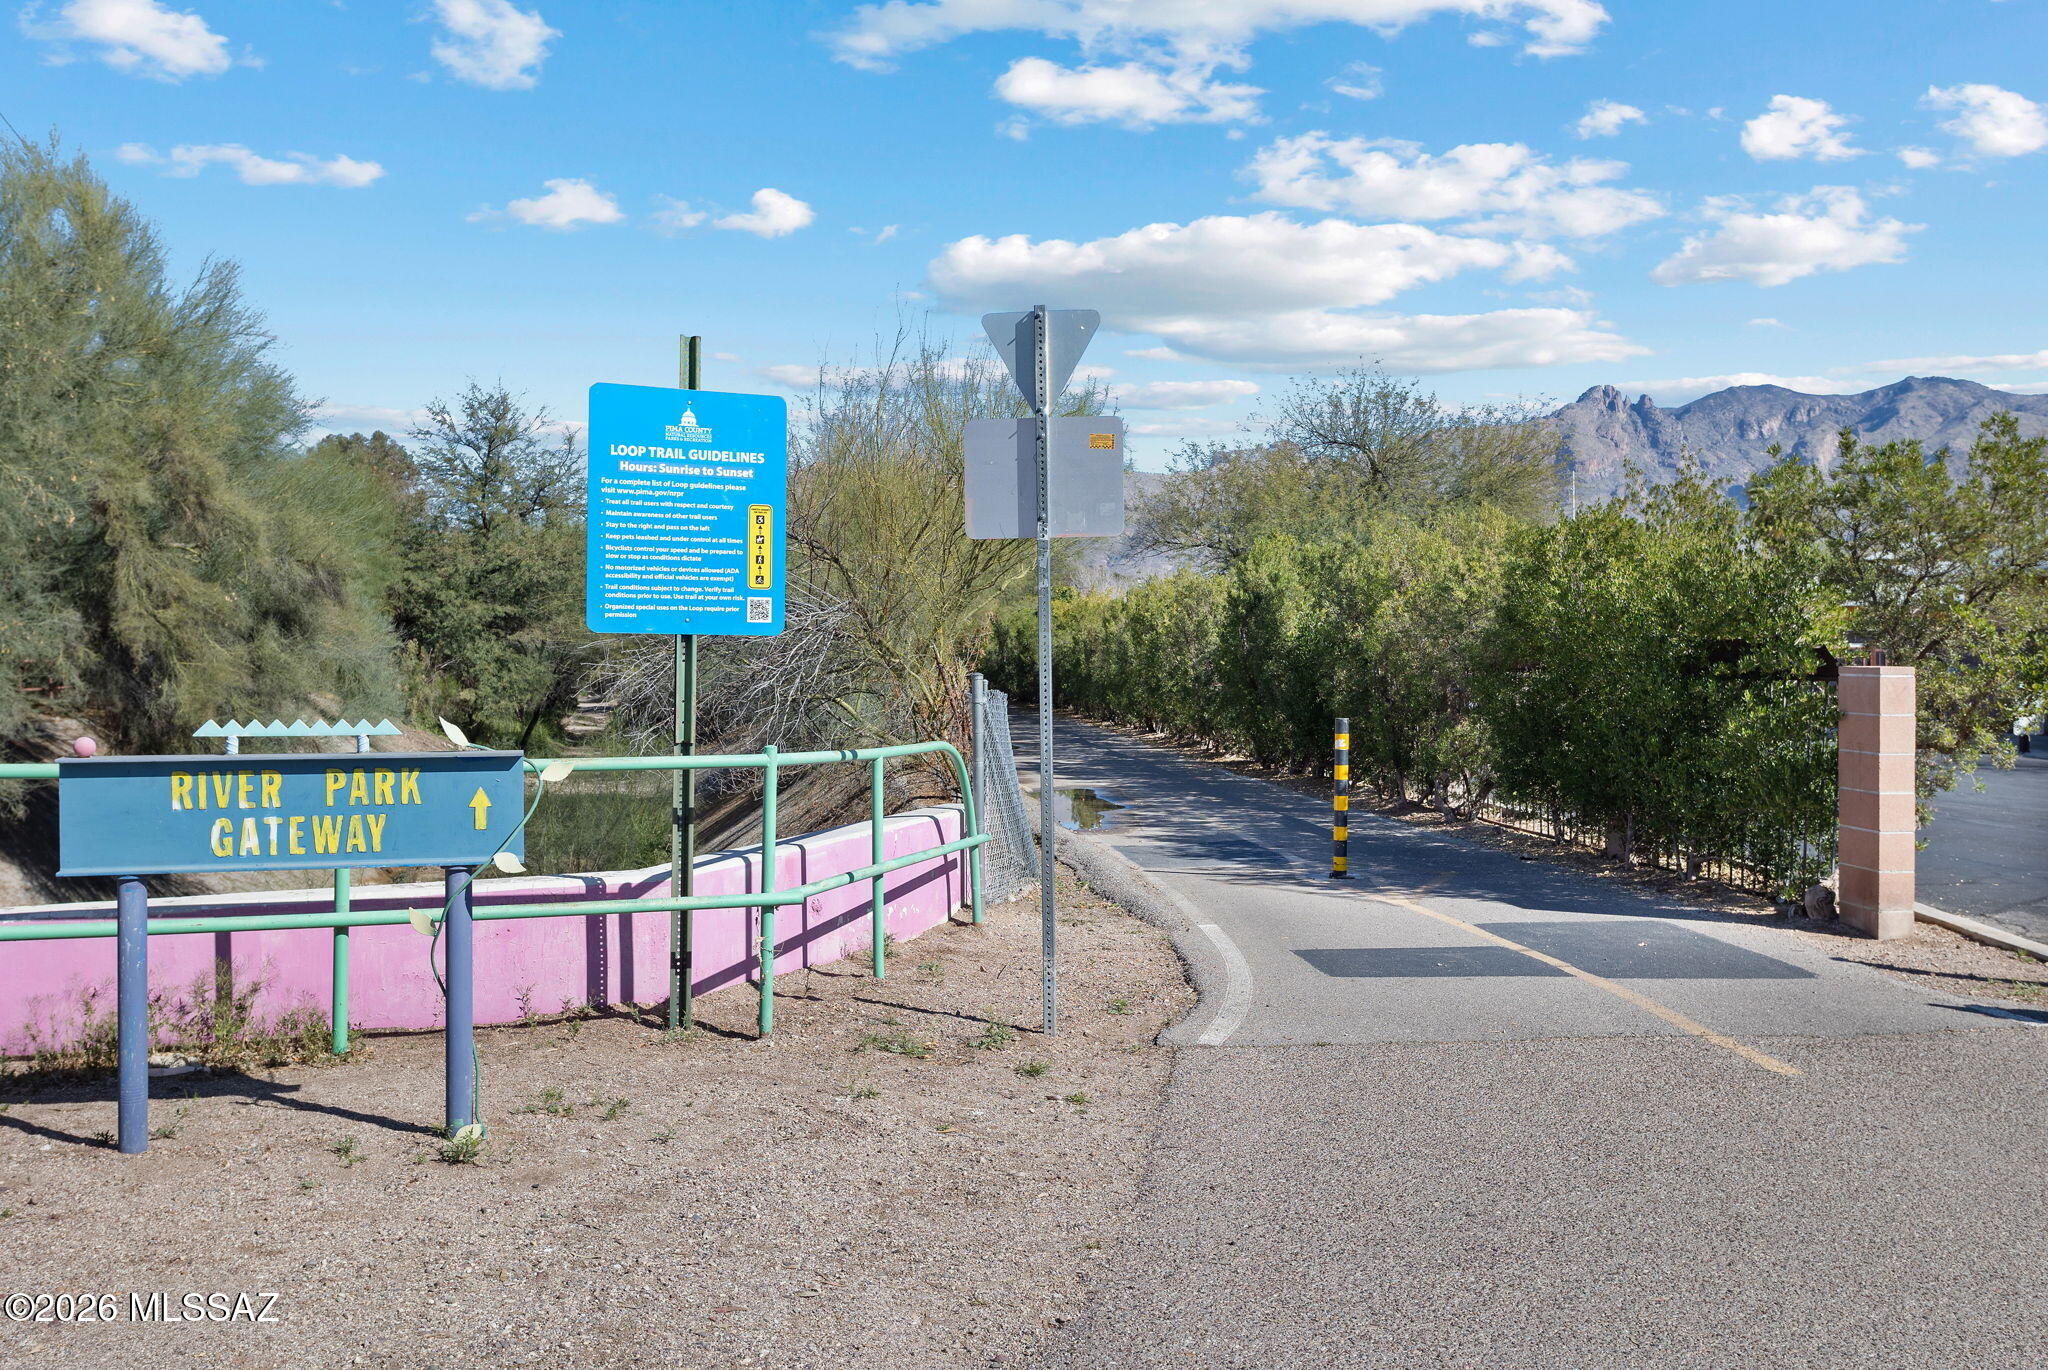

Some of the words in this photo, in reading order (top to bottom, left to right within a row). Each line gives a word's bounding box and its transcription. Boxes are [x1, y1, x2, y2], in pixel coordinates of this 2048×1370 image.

[684, 426, 712, 434] COUNTY
[610, 444, 646, 456] LOOP
[649, 447, 686, 459] TRAIL
[688, 449, 765, 464] GUIDELINES
[619, 461, 657, 473] Hours:
[659, 464, 700, 475] Sunrise
[701, 467, 713, 476] to
[715, 467, 754, 478] Sunset
[671, 481, 689, 490] Loop
[689, 482, 724, 490] guidelines
[724, 483, 747, 492] please
[605, 509, 633, 517] Maintain
[605, 521, 619, 529] Stay
[605, 544, 633, 552] Bicyclists
[605, 572, 641, 580] accessibility
[604, 603, 635, 611] Organized
[171, 769, 283, 811] RIVER
[326, 767, 422, 807] PARK
[210, 813, 388, 859] GATEWAY
